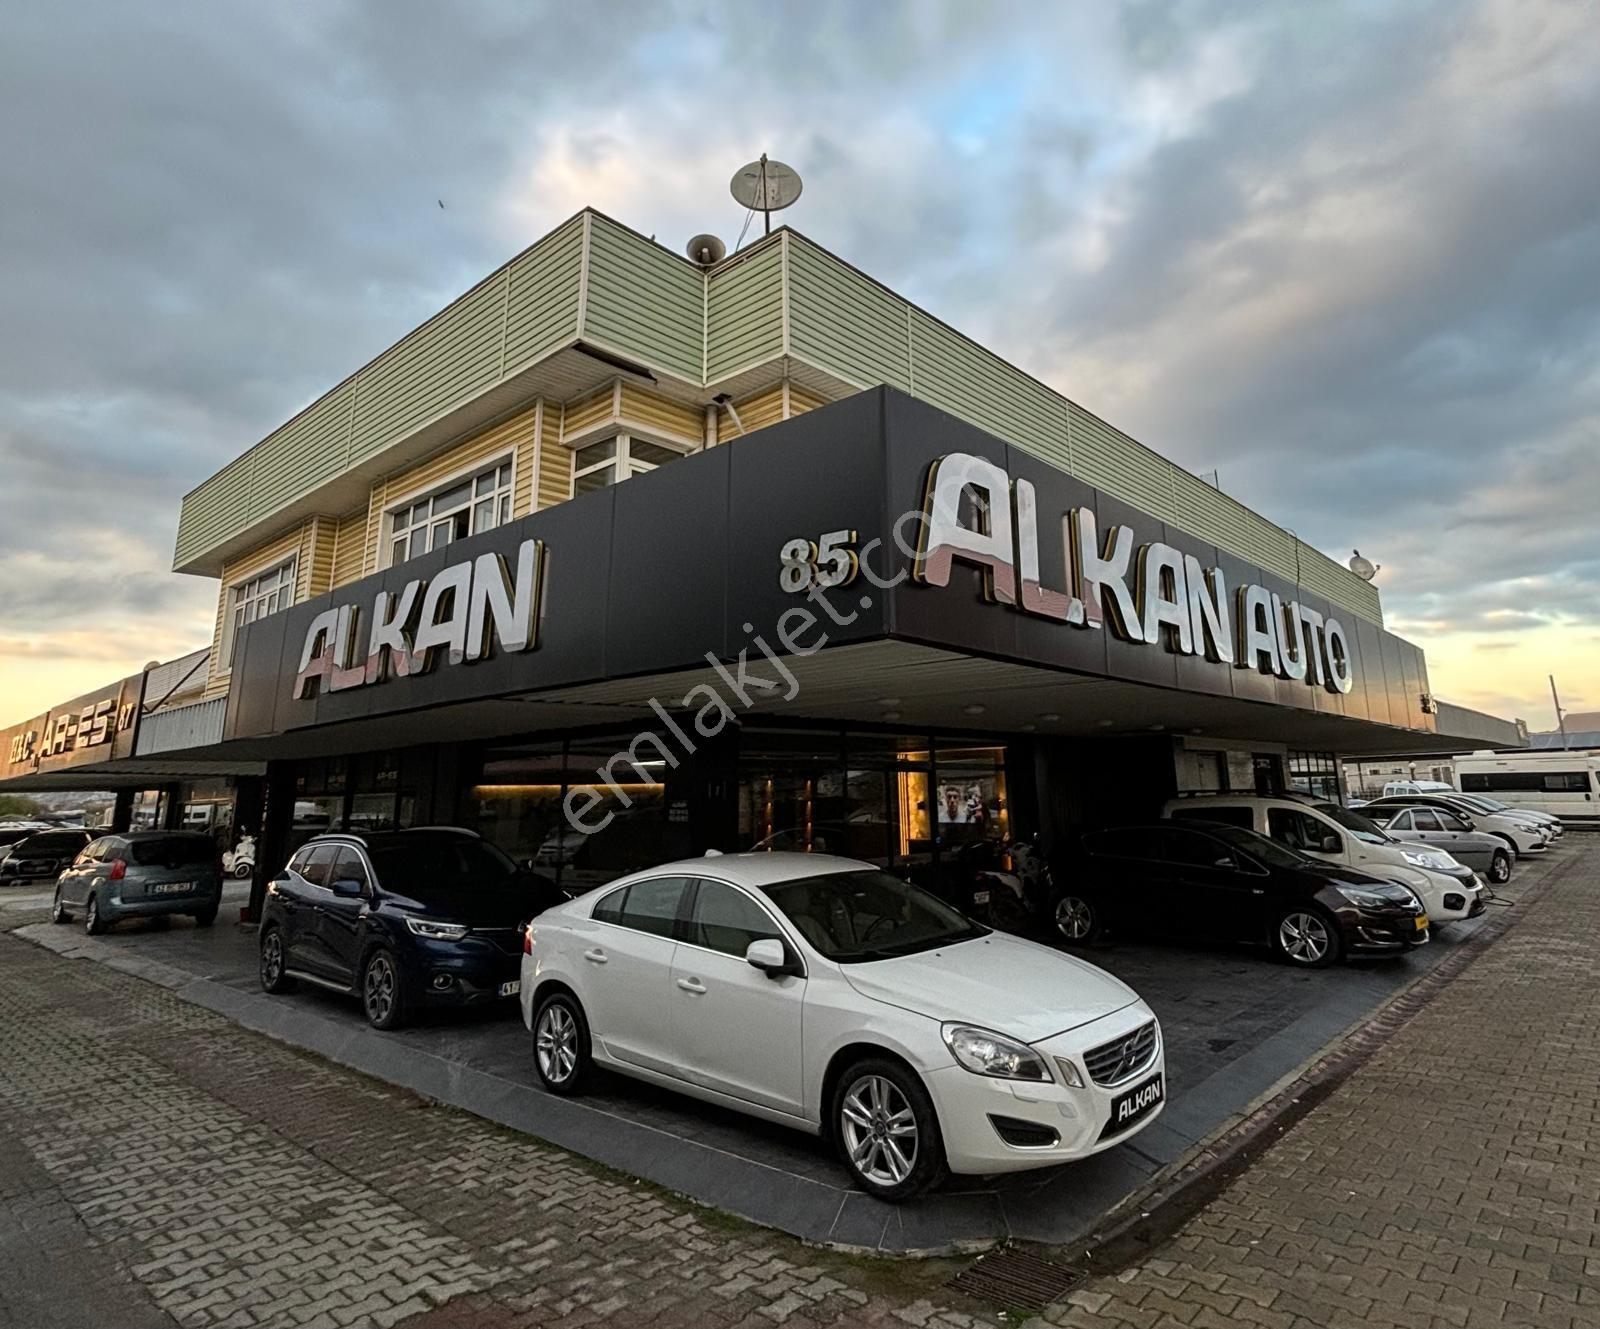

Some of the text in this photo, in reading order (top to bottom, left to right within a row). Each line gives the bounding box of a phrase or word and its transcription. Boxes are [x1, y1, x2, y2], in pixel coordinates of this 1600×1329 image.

[779, 530, 857, 593] 85
[913, 452, 1352, 694] ALKAN AUTO
[292, 538, 538, 700] ALKAN
[39, 699, 112, 758] AR-ES
[118, 703, 135, 731] 87
[1118, 1080, 1160, 1122] ALKAN
